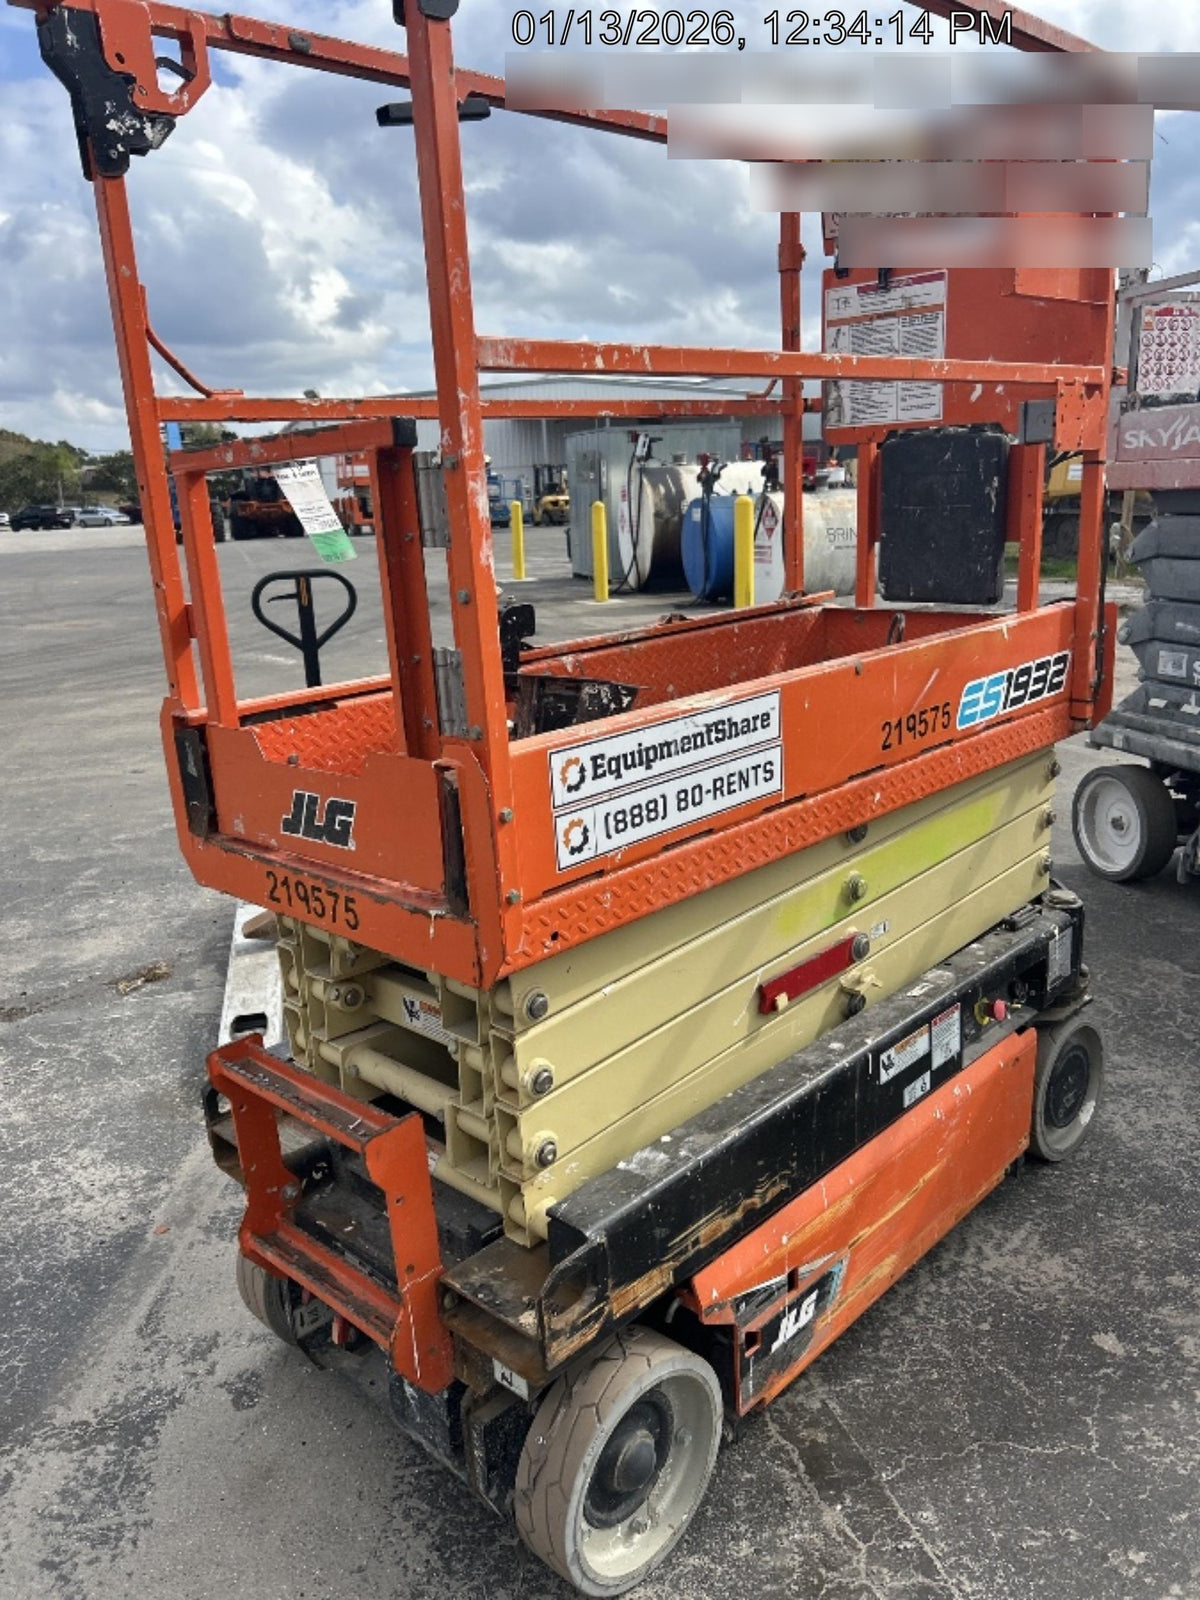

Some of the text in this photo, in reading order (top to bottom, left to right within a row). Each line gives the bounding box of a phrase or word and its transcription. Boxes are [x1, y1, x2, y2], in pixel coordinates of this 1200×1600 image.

[957, 650, 1072, 730] ES1932
[590, 712, 771, 780] EquipmentShare
[881, 702, 951, 751] 219575
[280, 789, 356, 851] JLG
[603, 760, 775, 840] (888) 80-RENTS
[266, 870, 360, 931] 219575
[771, 1288, 819, 1354] JLG
